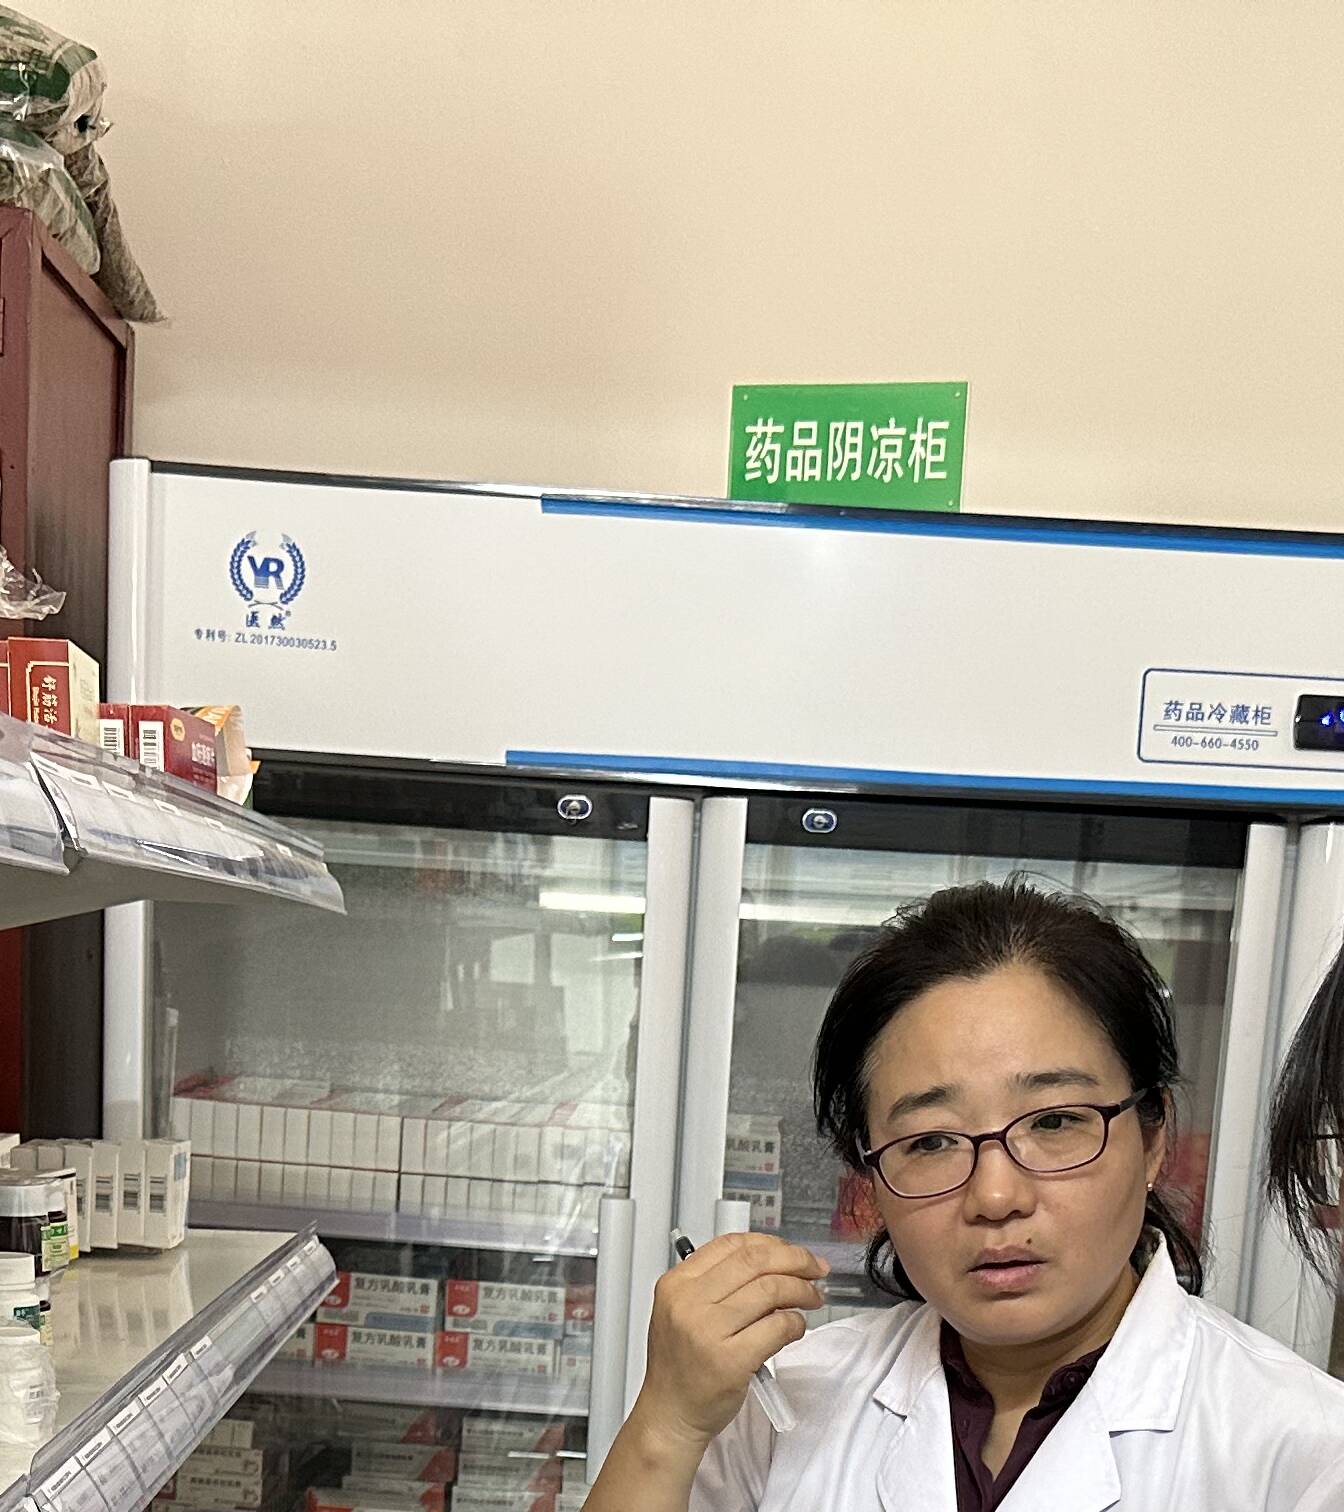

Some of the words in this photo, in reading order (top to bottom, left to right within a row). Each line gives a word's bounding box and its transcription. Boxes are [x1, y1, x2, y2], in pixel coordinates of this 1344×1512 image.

[744, 417, 951, 484] 药品阴凉柜
[1163, 700, 1273, 726] 药品冷藏柜
[1170, 734, 1260, 752] 400-660-4550
